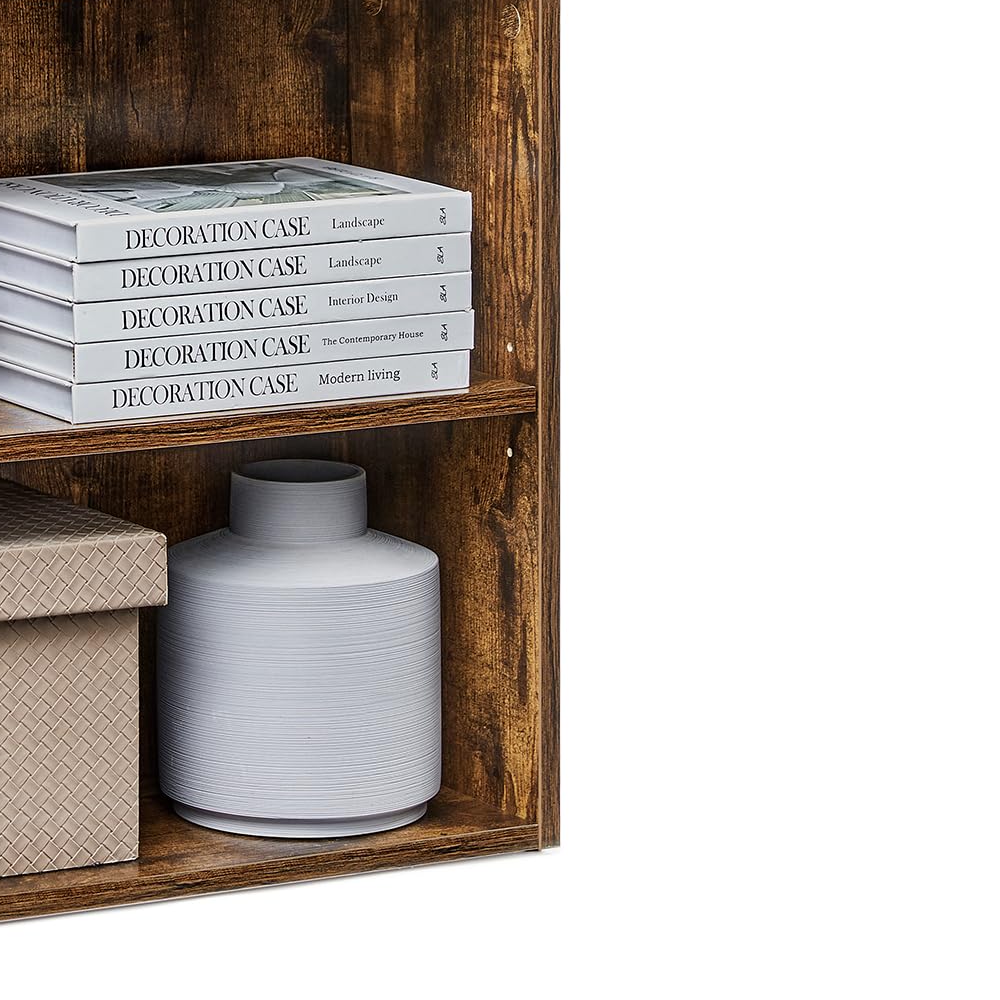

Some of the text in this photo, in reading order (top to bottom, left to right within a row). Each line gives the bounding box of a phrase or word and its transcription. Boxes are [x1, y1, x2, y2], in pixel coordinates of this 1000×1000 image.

[125, 216, 385, 250] DECORATION CASE Landscape
[121, 255, 382, 289] DECORATION CASE Landscape
[121, 291, 399, 330] DECORATION CASE Interior Design
[124, 330, 424, 370] DECORATION CASE The Contemporary House
[112, 368, 401, 409] DECORATION CASE Modern living
